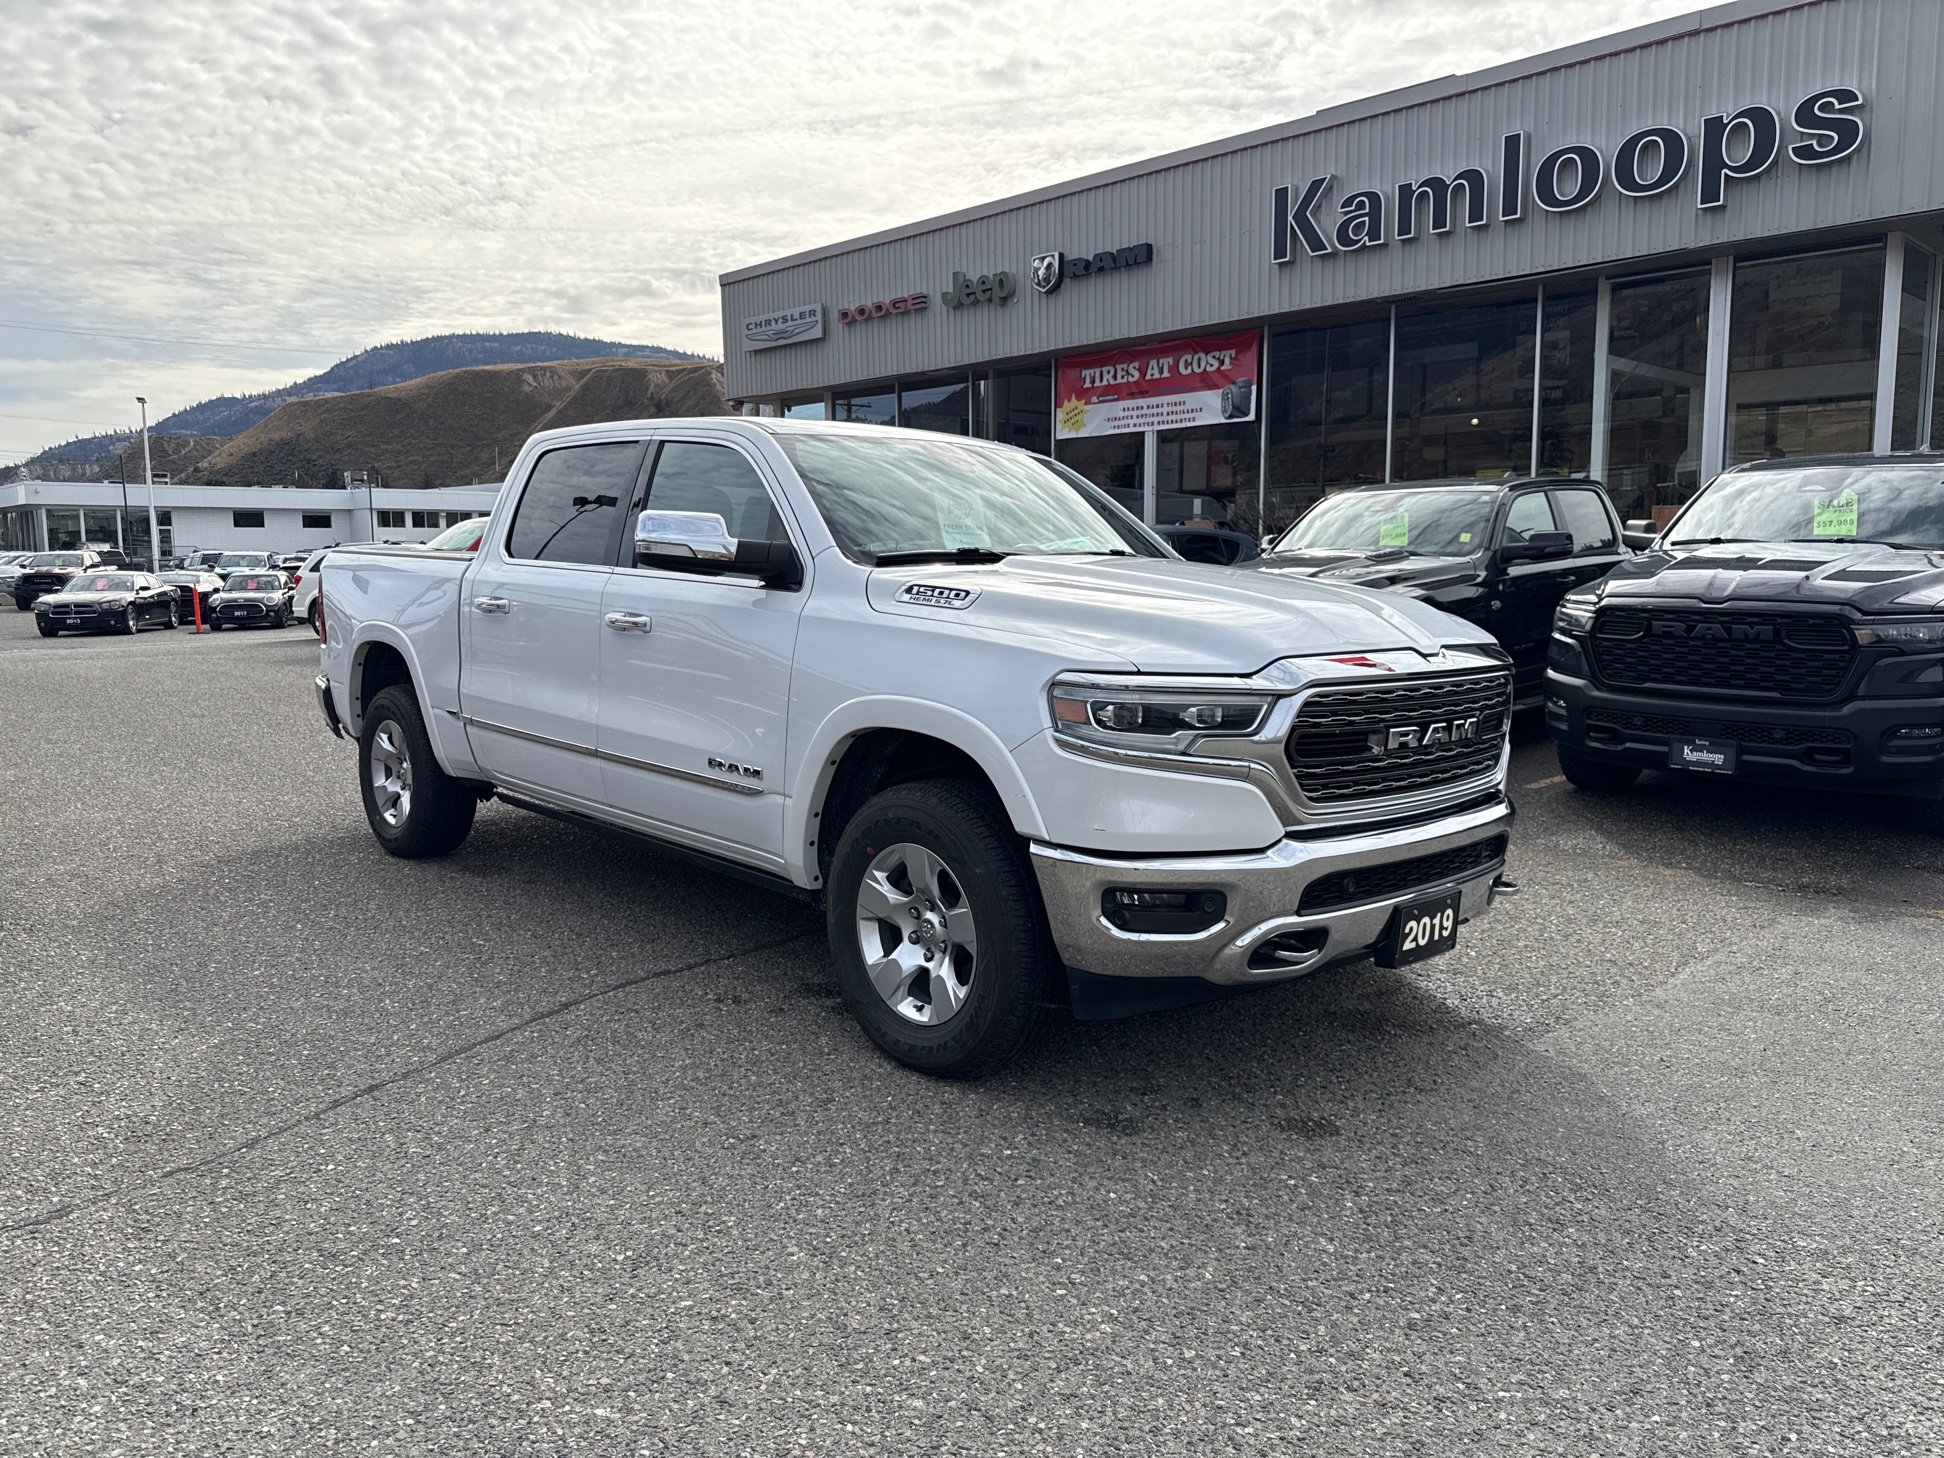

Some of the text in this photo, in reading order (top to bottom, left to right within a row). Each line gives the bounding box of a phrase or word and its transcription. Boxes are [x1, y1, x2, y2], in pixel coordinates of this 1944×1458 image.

[1271, 85, 1868, 265] Kamloops
[1064, 242, 1153, 279] RAM
[941, 270, 1016, 309] Jeep
[838, 292, 929, 325] DODGE
[745, 308, 818, 332] CHRYSLER
[1081, 348, 1236, 388] TIRES AT COST
[1107, 407, 1203, 423] FINANCE OPTIONS AVAILABLE
[1122, 400, 1186, 413] BRAND NAME TIRES
[1063, 409, 1084, 424] SAVINGS
[1156, 416, 1196, 426] GUARANTEE
[1817, 498, 1854, 509] SALE
[964, 524, 985, 532] TRADE
[1816, 519, 1855, 529] $57,988
[908, 595, 933, 604] HEMI
[910, 585, 967, 599] 1500
[1651, 620, 1774, 641] RAM
[1387, 717, 1478, 750] RAM
[1683, 745, 1724, 763] Kamloops
[707, 757, 763, 781] RAM
[1402, 908, 1454, 951] 2019
